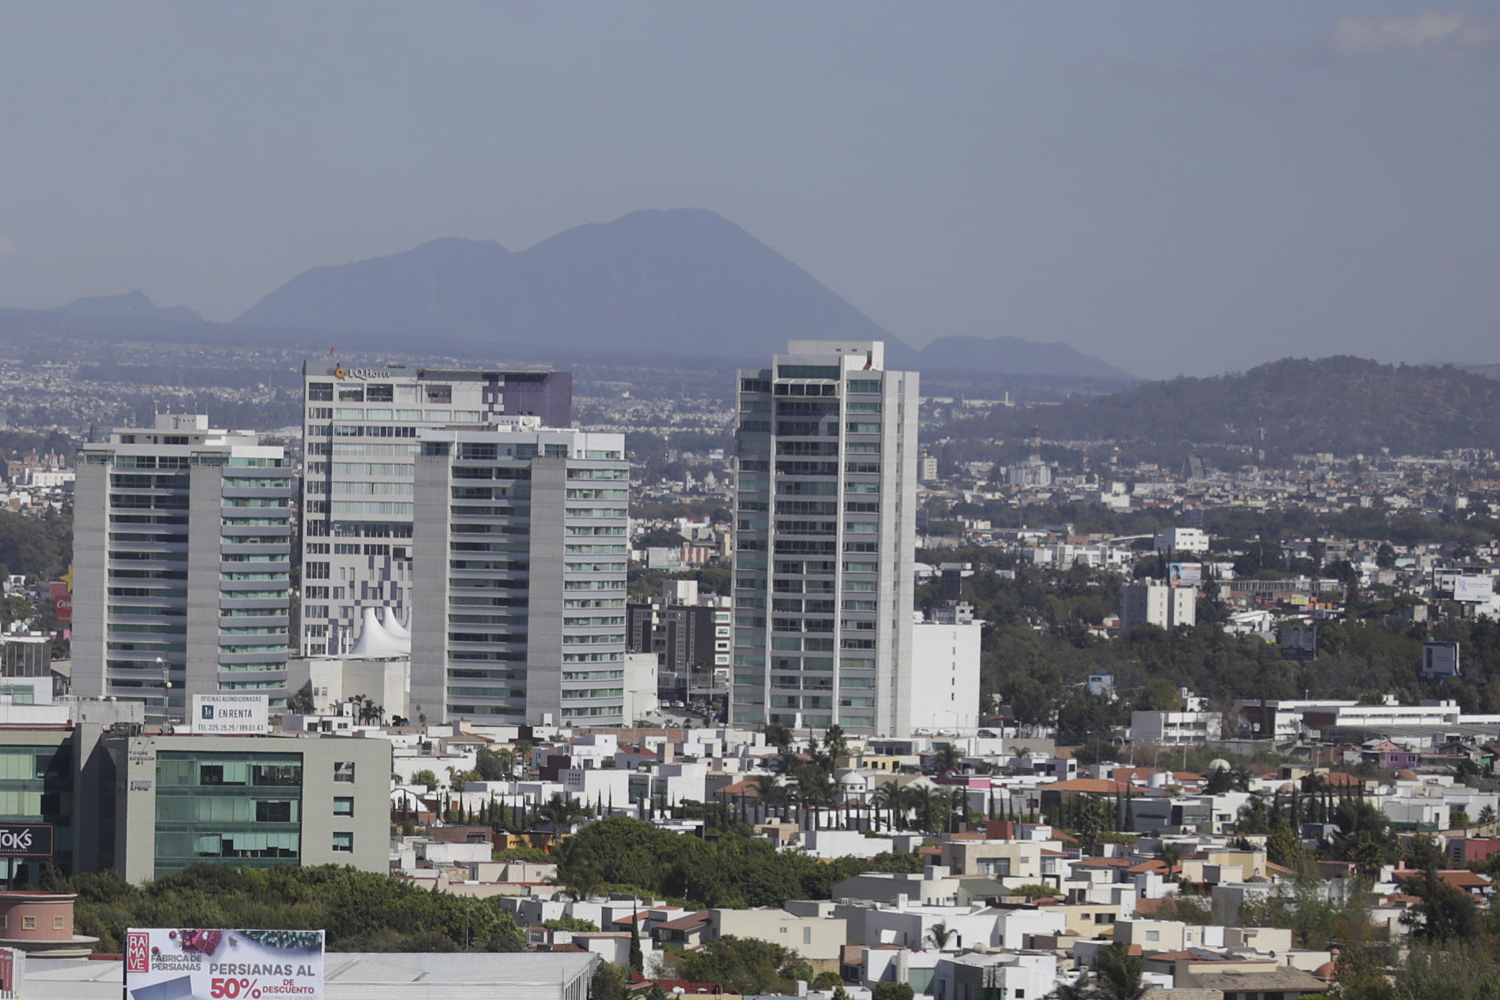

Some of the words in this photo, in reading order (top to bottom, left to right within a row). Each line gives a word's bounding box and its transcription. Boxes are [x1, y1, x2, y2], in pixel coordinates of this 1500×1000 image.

[218, 709, 228, 718] EN
[228, 709, 252, 718] RENTA
[190, 955, 202, 963] DE
[151, 963, 201, 971] PERSIANAS
[209, 964, 293, 976] PERSIANAS
[296, 965, 316, 976] AL
[211, 978, 261, 999] 50%
[262, 986, 315, 994] DESCUENTO
